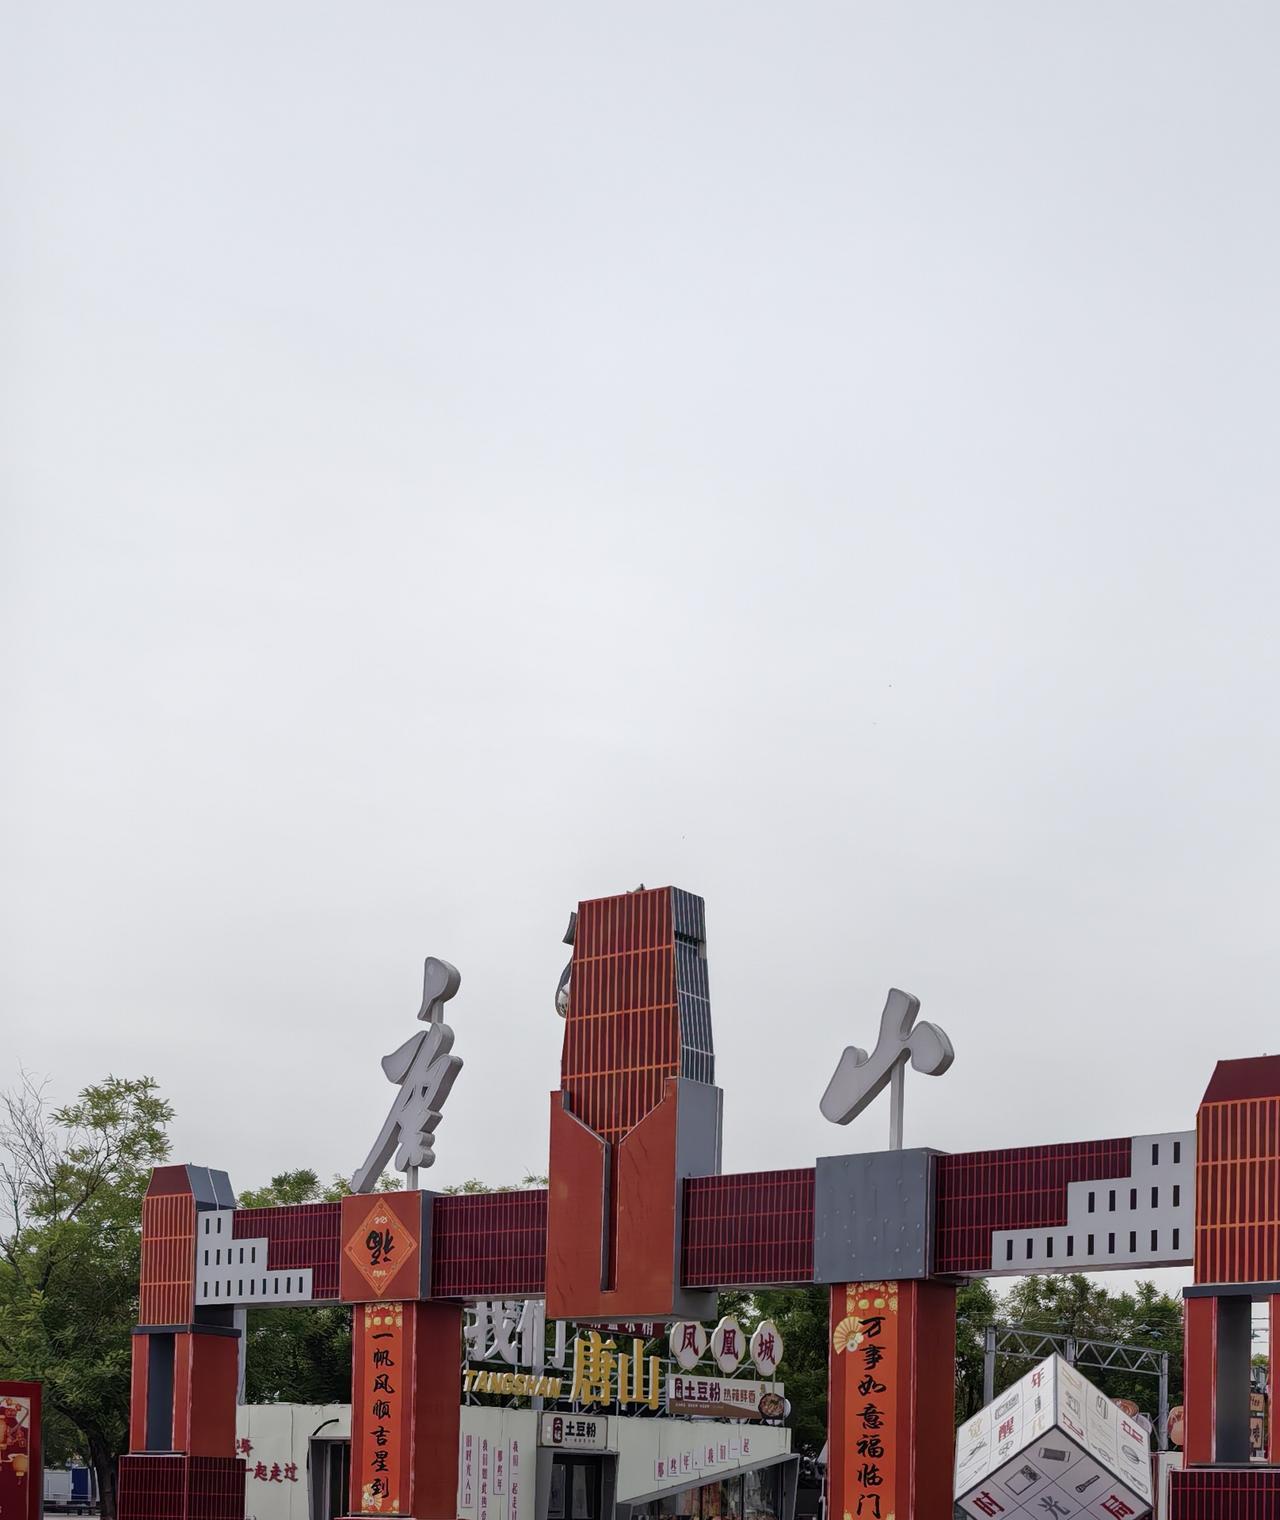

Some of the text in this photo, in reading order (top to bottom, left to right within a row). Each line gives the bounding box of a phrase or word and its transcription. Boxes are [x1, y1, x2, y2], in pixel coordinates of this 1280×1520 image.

[365, 1228, 396, 1266] 福
[679, 1324, 776, 1365] 凤凰城
[463, 1369, 562, 1399] TANGSHAN
[569, 1331, 661, 1409] 唐山
[684, 1380, 721, 1402] 土豆粉
[370, 1332, 396, 1499] 一帆风顺吉星到
[565, 1421, 597, 1438] 土豆粉
[856, 1316, 887, 1519] 万事如意福临门
